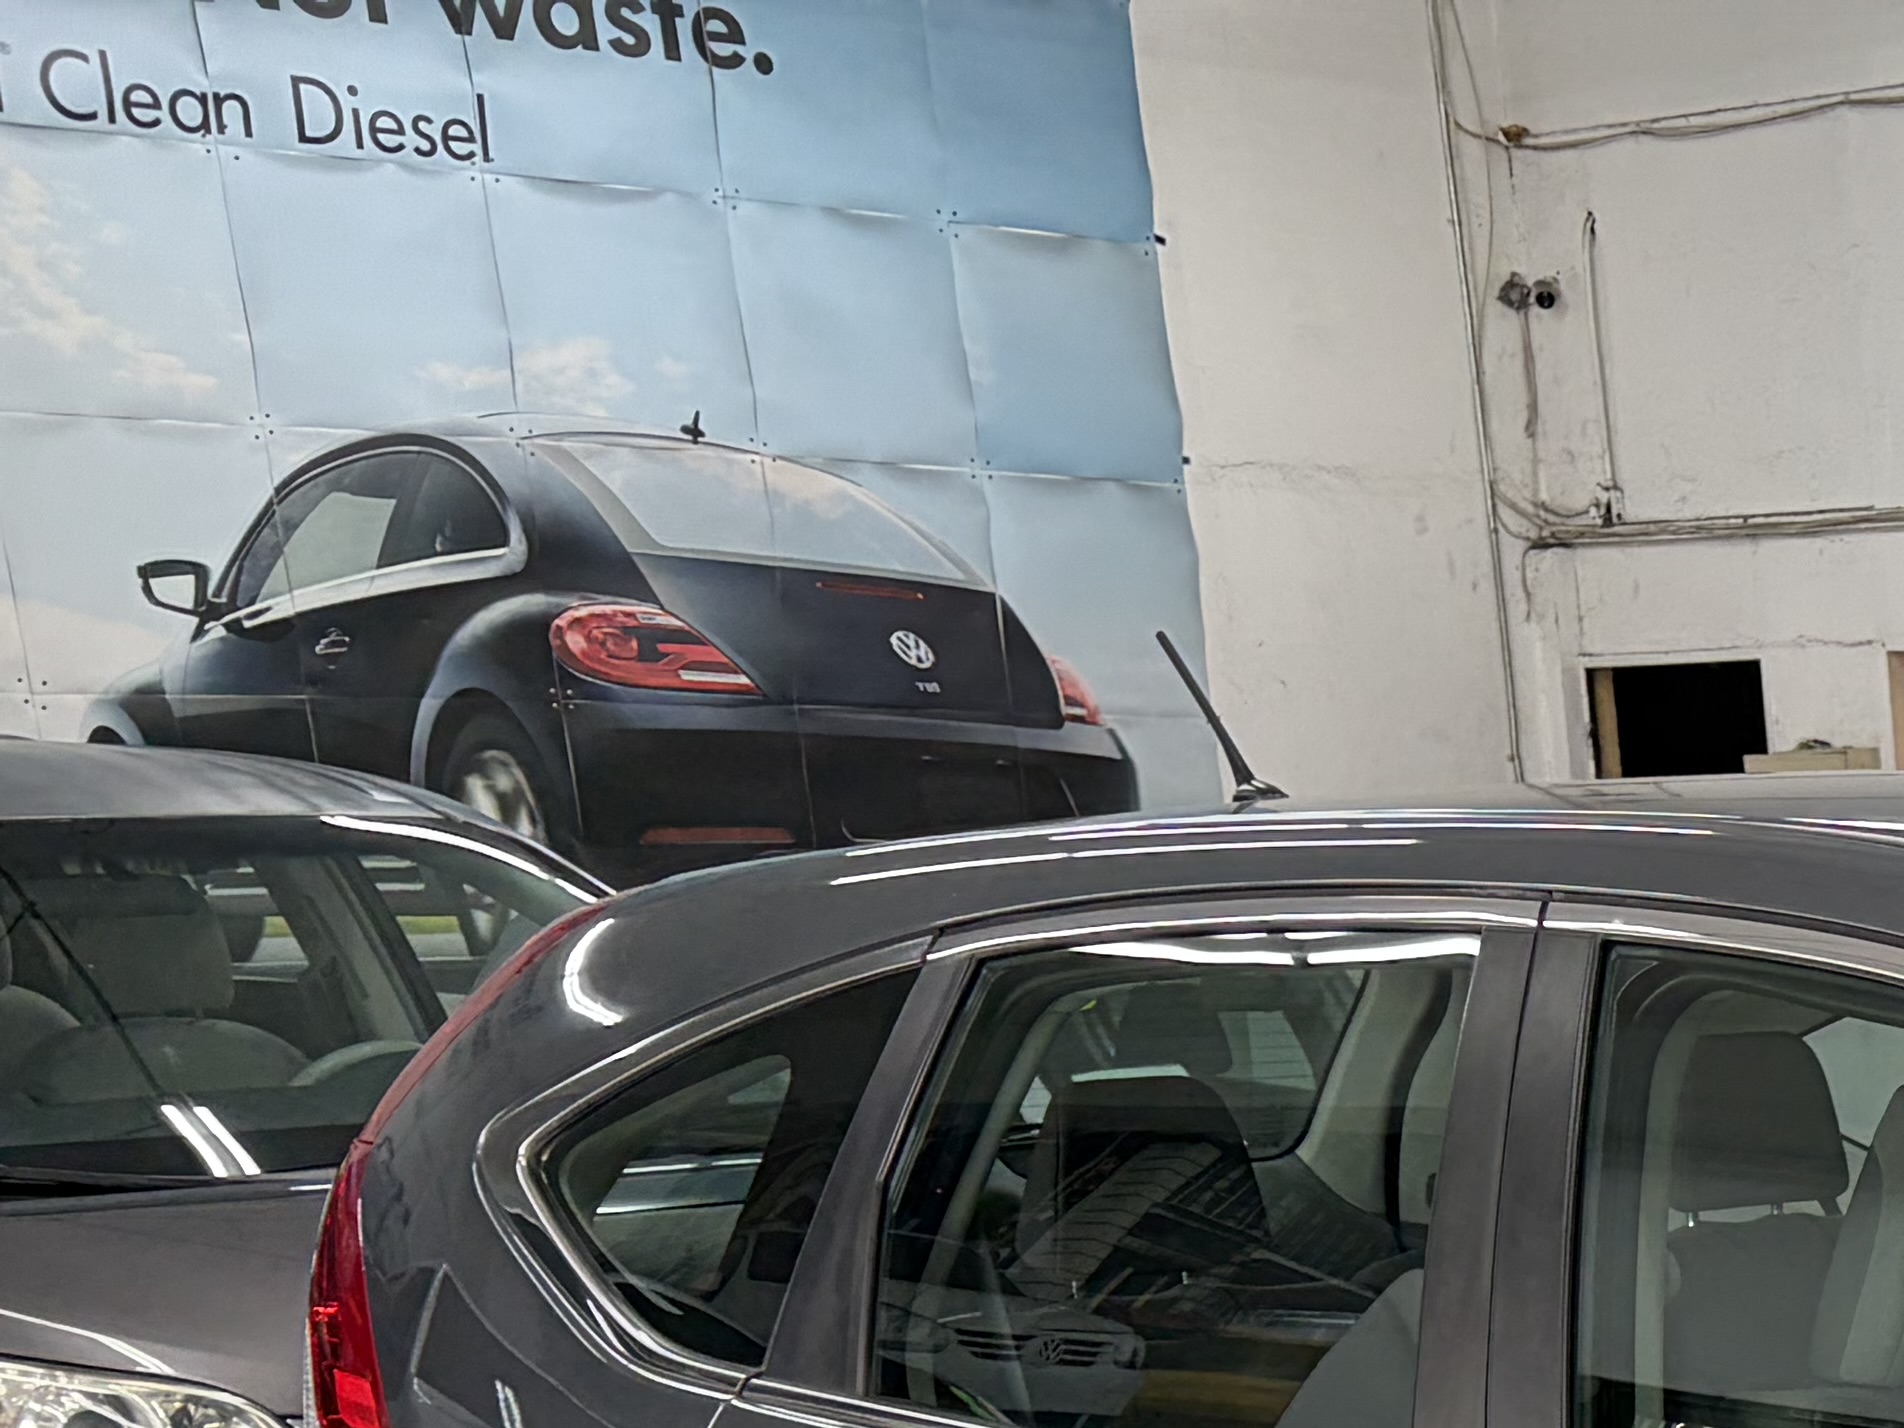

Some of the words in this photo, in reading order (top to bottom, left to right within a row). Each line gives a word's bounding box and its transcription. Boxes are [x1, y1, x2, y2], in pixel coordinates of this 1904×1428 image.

[439, 0, 773, 76] waste.
[40, 49, 253, 139] Clean
[290, 75, 495, 163] Diesel
